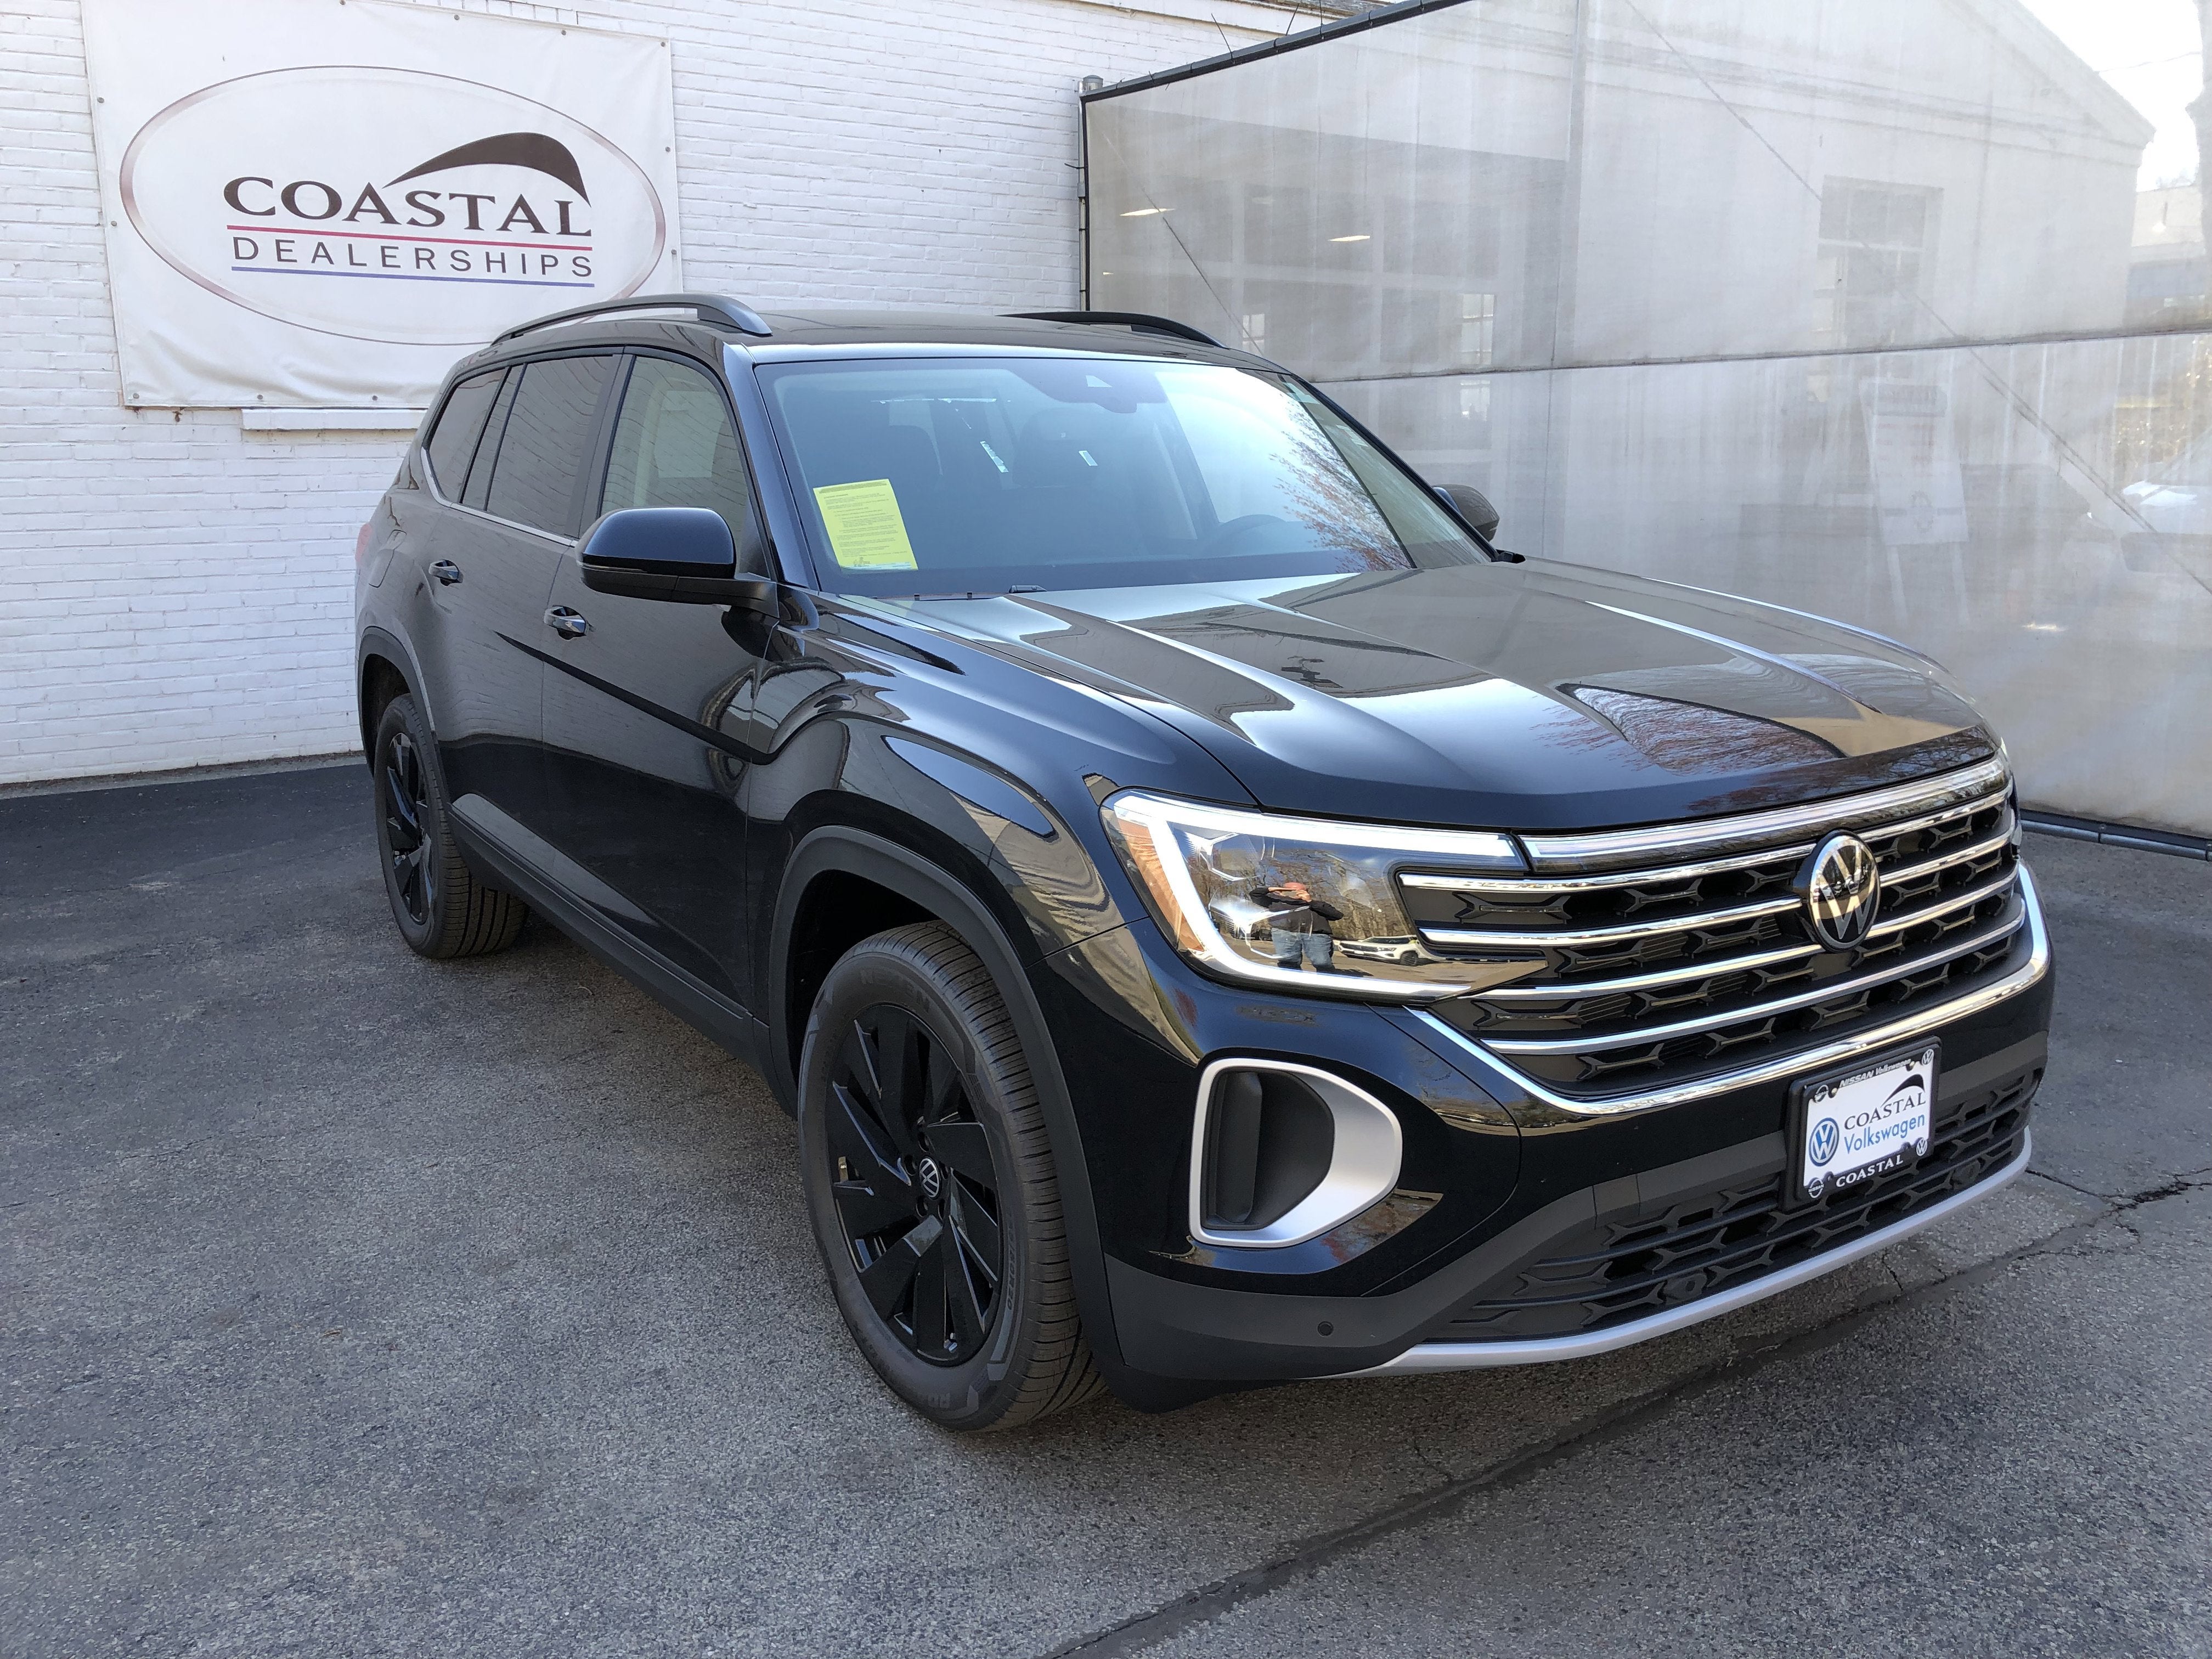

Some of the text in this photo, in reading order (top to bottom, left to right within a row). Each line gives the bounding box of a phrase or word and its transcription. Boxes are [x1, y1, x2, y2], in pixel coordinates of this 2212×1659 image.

[223, 176, 592, 237] COASTAL
[234, 236, 592, 278] DEALERSHIPS
[1839, 1070, 1875, 1088] NISSAN
[1844, 1092, 1926, 1130] COASTAL
[1844, 1114, 1925, 1154] Volkswagen
[1836, 1154, 1904, 1187] COASTAL
